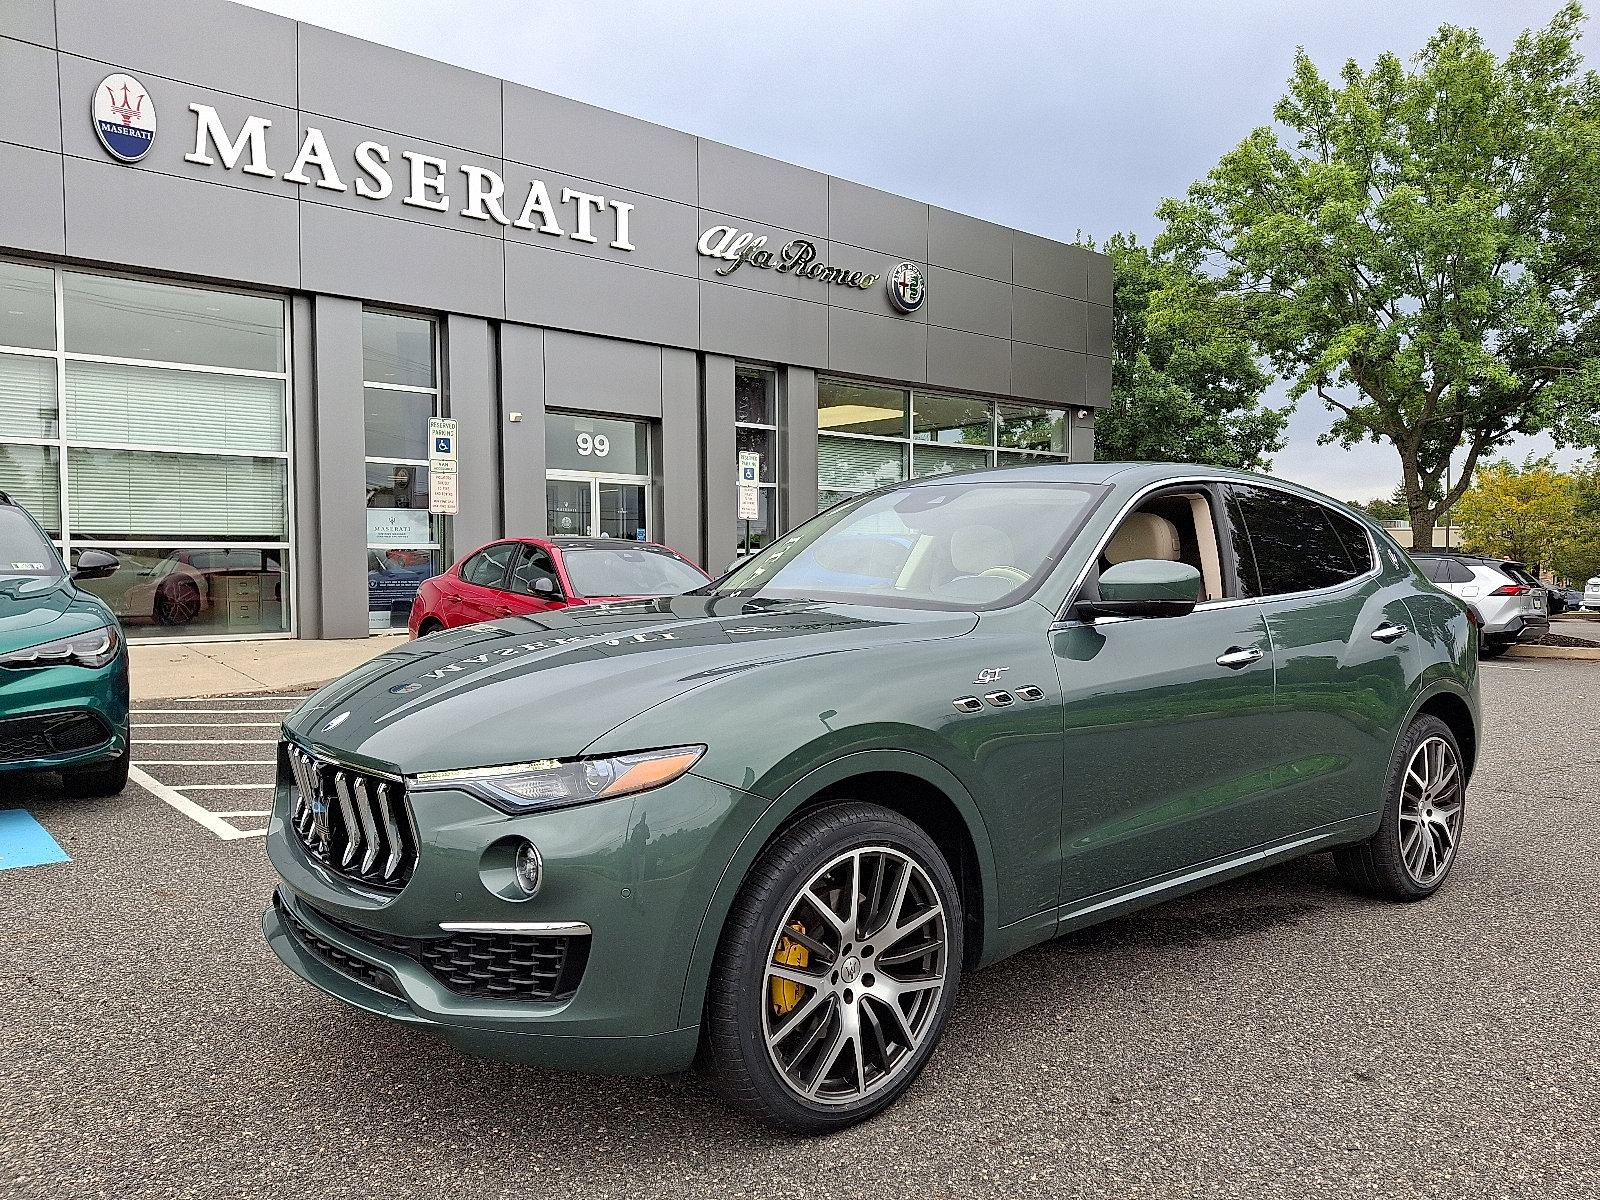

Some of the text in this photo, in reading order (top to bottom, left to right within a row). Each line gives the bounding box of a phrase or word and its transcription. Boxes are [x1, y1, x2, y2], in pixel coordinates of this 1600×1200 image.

[101, 123, 152, 141] MASERATI
[184, 102, 636, 251] MASERATI
[776, 239, 880, 289] Romeo
[430, 421, 456, 430] RESERVED
[432, 429, 454, 437] PARKING
[576, 433, 610, 457] 99
